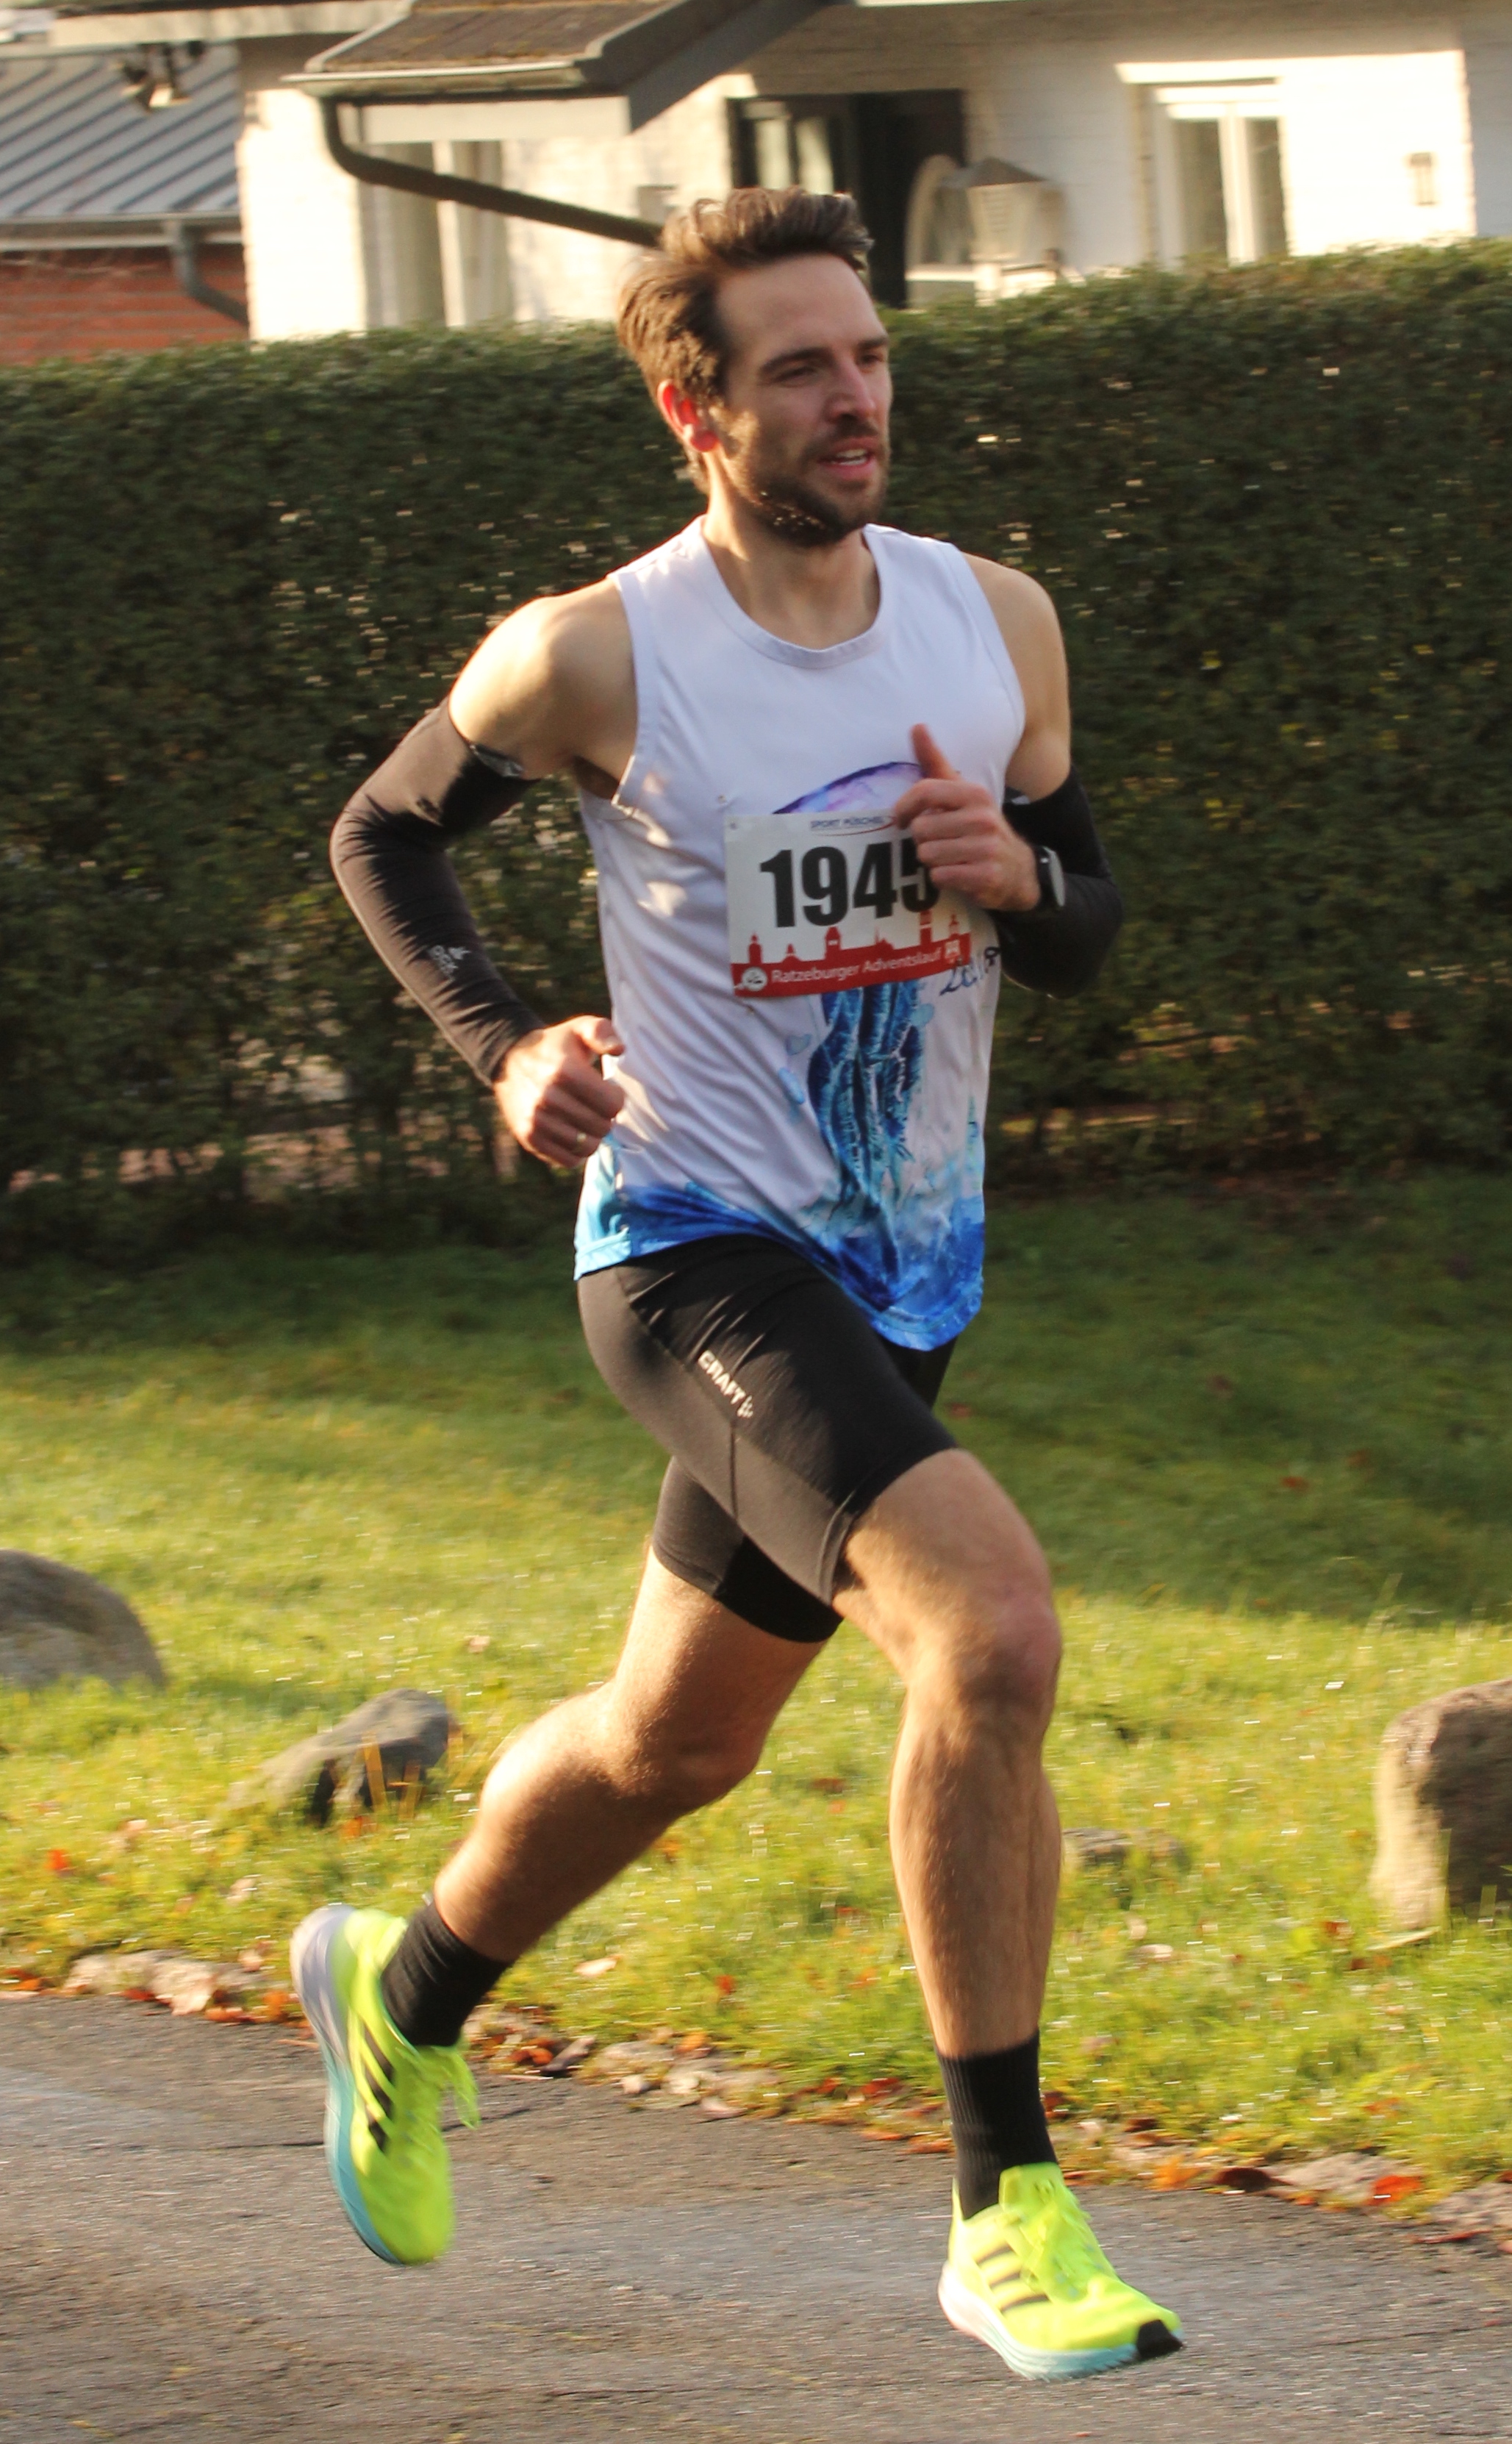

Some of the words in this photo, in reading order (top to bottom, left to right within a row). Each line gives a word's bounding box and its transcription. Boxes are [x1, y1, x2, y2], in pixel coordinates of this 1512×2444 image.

[760, 837, 939, 928] 1945
[772, 965, 859, 983] Ratzeburger
[862, 946, 942, 972] Adventslauf
[698, 1350, 747, 1404] CRAFT
